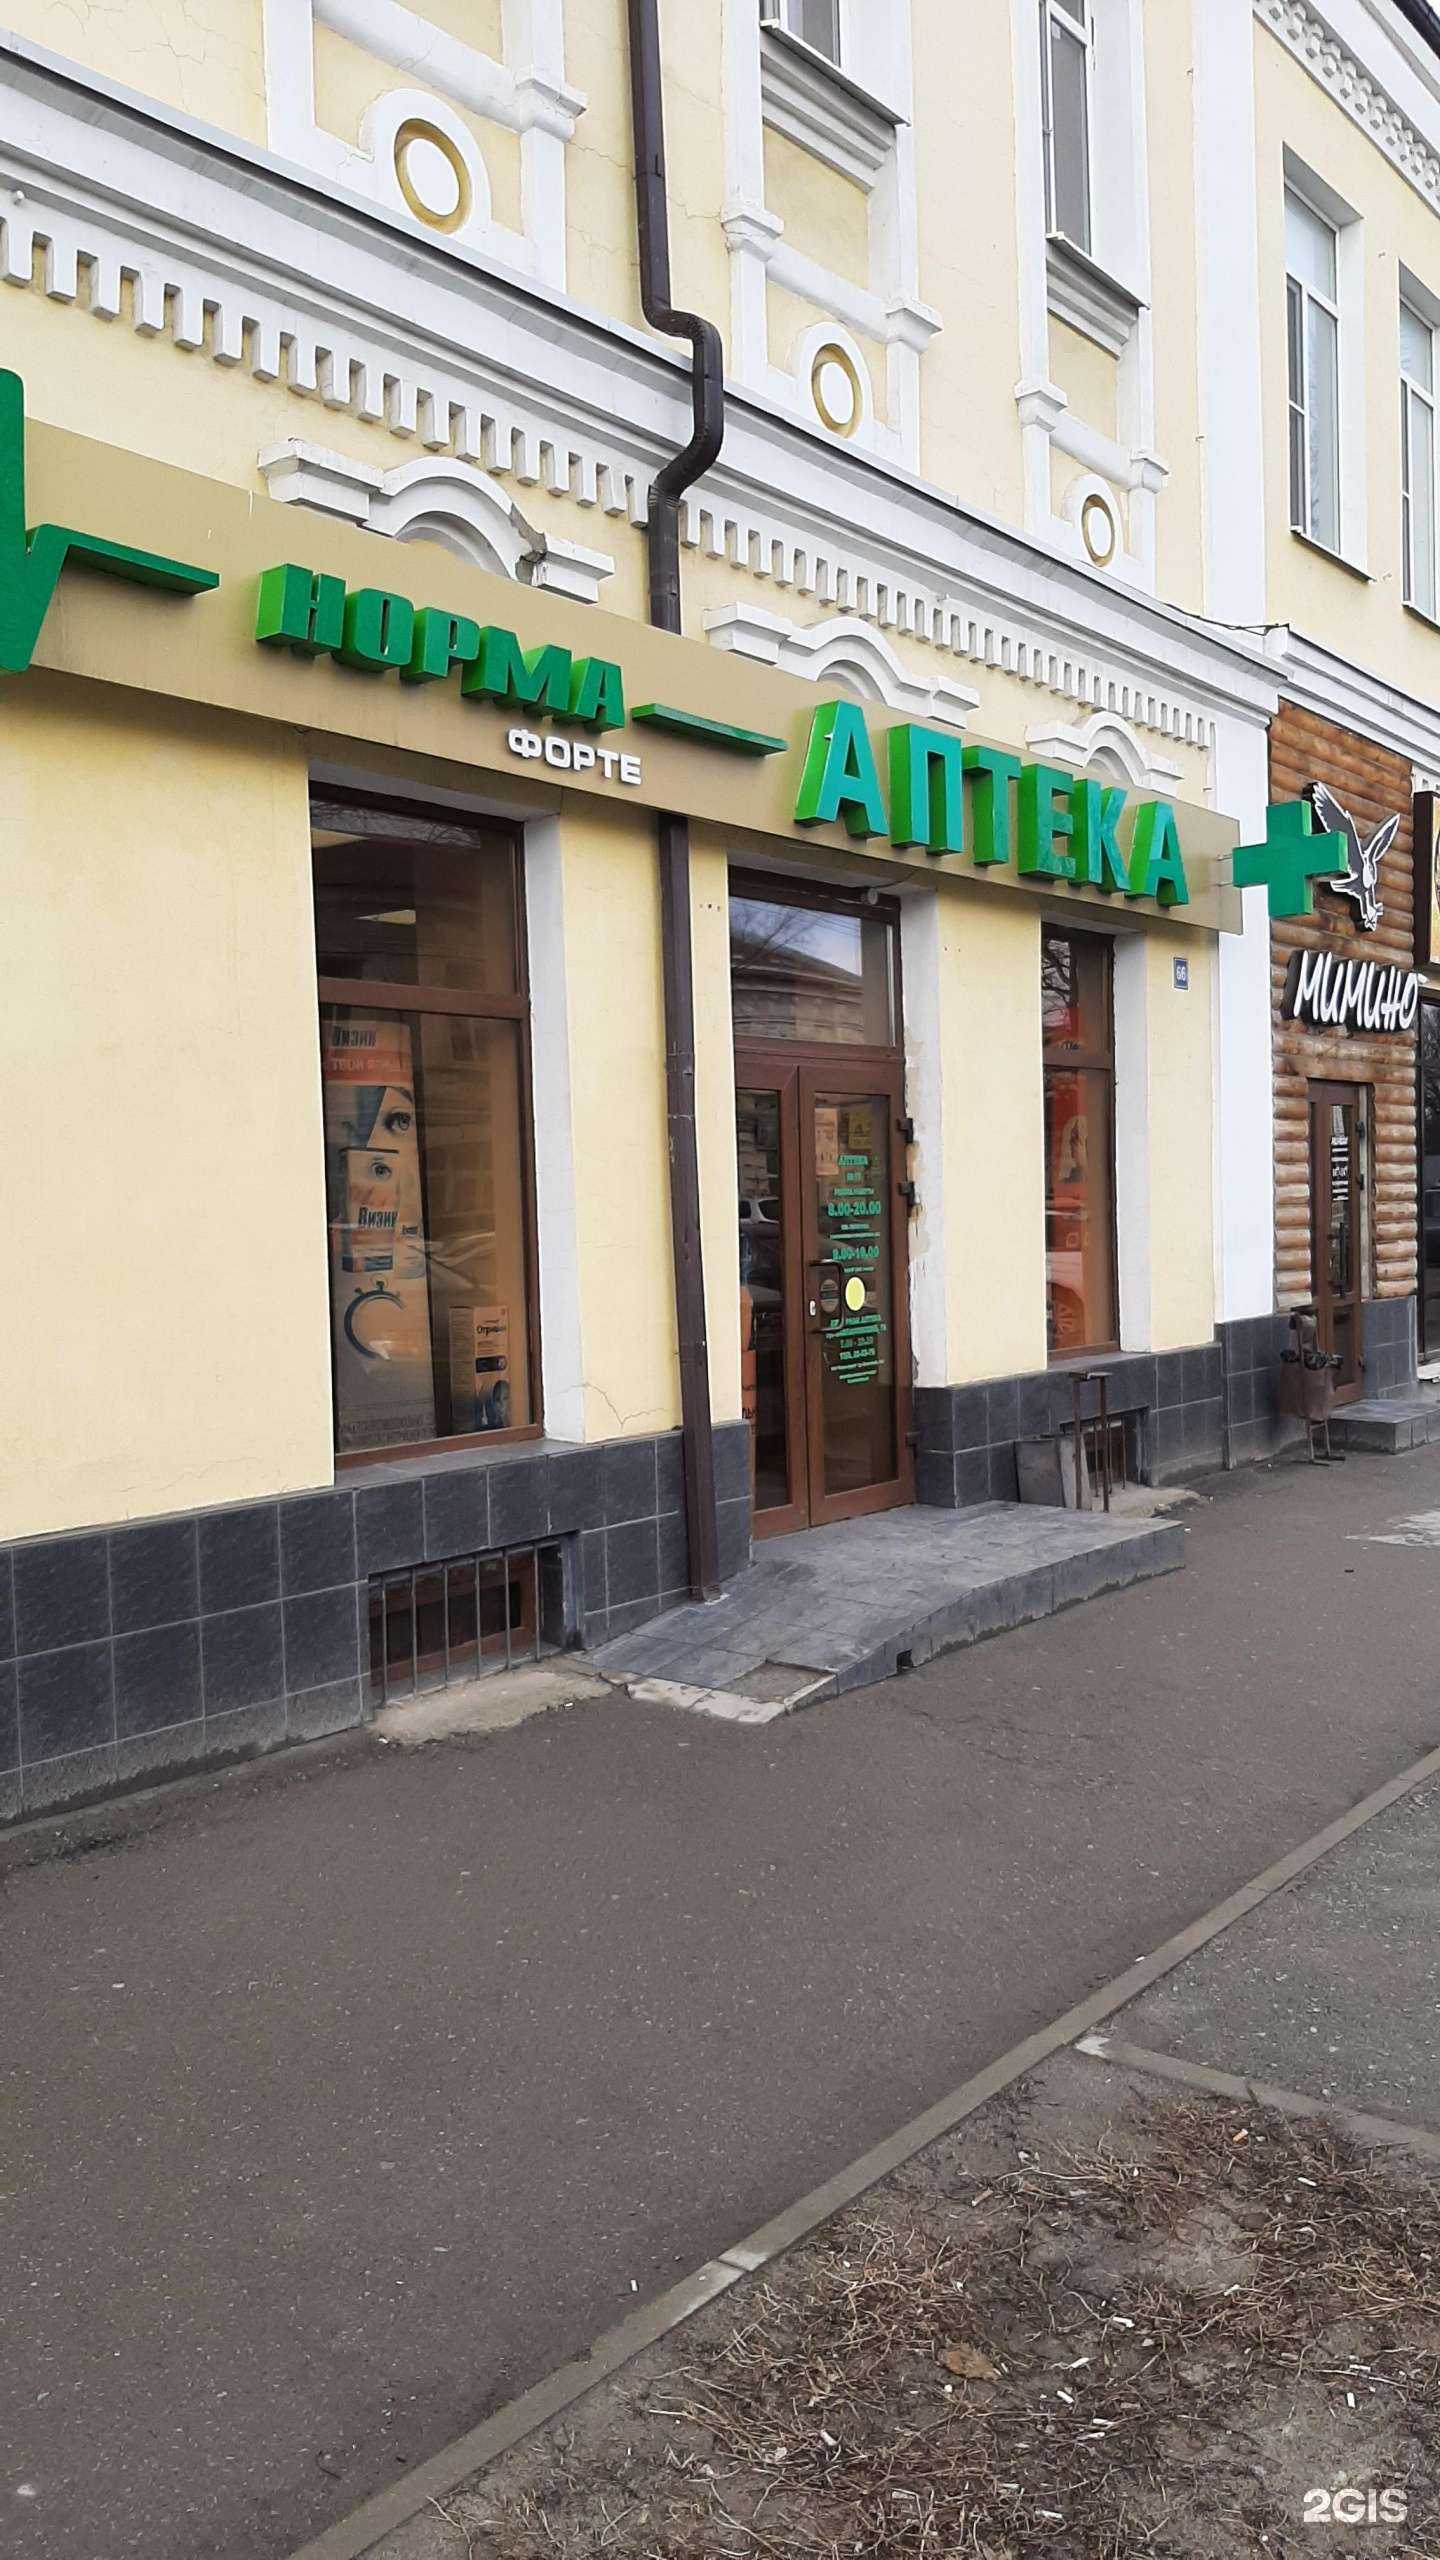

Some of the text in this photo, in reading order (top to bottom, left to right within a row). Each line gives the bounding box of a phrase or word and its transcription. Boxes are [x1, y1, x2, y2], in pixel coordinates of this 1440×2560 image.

[256, 563, 625, 732] НОРМА
[508, 728, 642, 785] ФОРТЕ
[795, 700, 1189, 907] АПТЕКА
[1294, 950, 1419, 1030] МИМИНО
